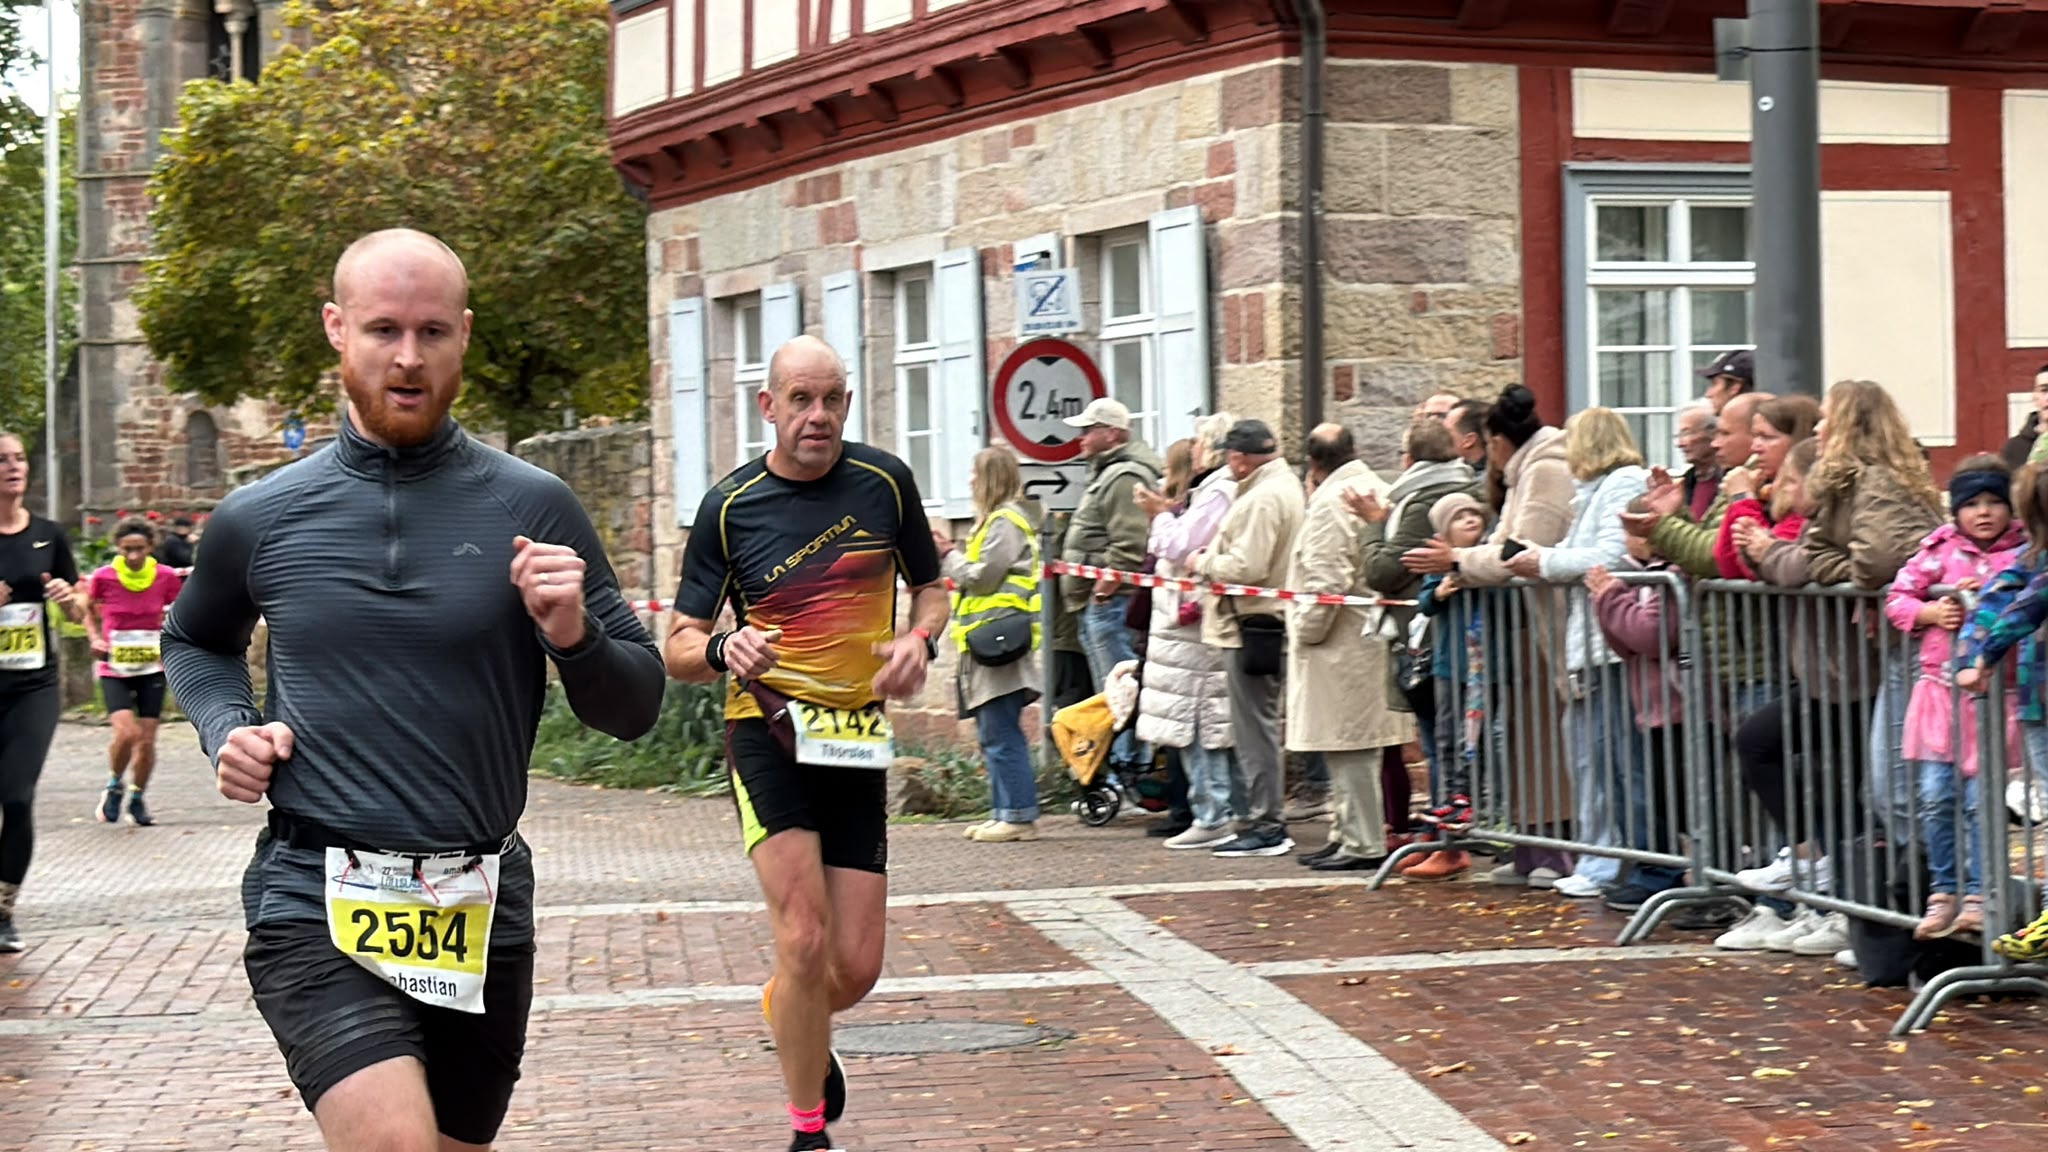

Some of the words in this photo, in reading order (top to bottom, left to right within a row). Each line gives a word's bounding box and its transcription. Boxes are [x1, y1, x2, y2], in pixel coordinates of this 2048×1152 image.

[1018, 380, 1083, 421] 2,4m
[763, 564, 787, 583] LA
[784, 514, 858, 569] SPORTIVA
[801, 703, 887, 737] 2142
[351, 908, 468, 963] 2554
